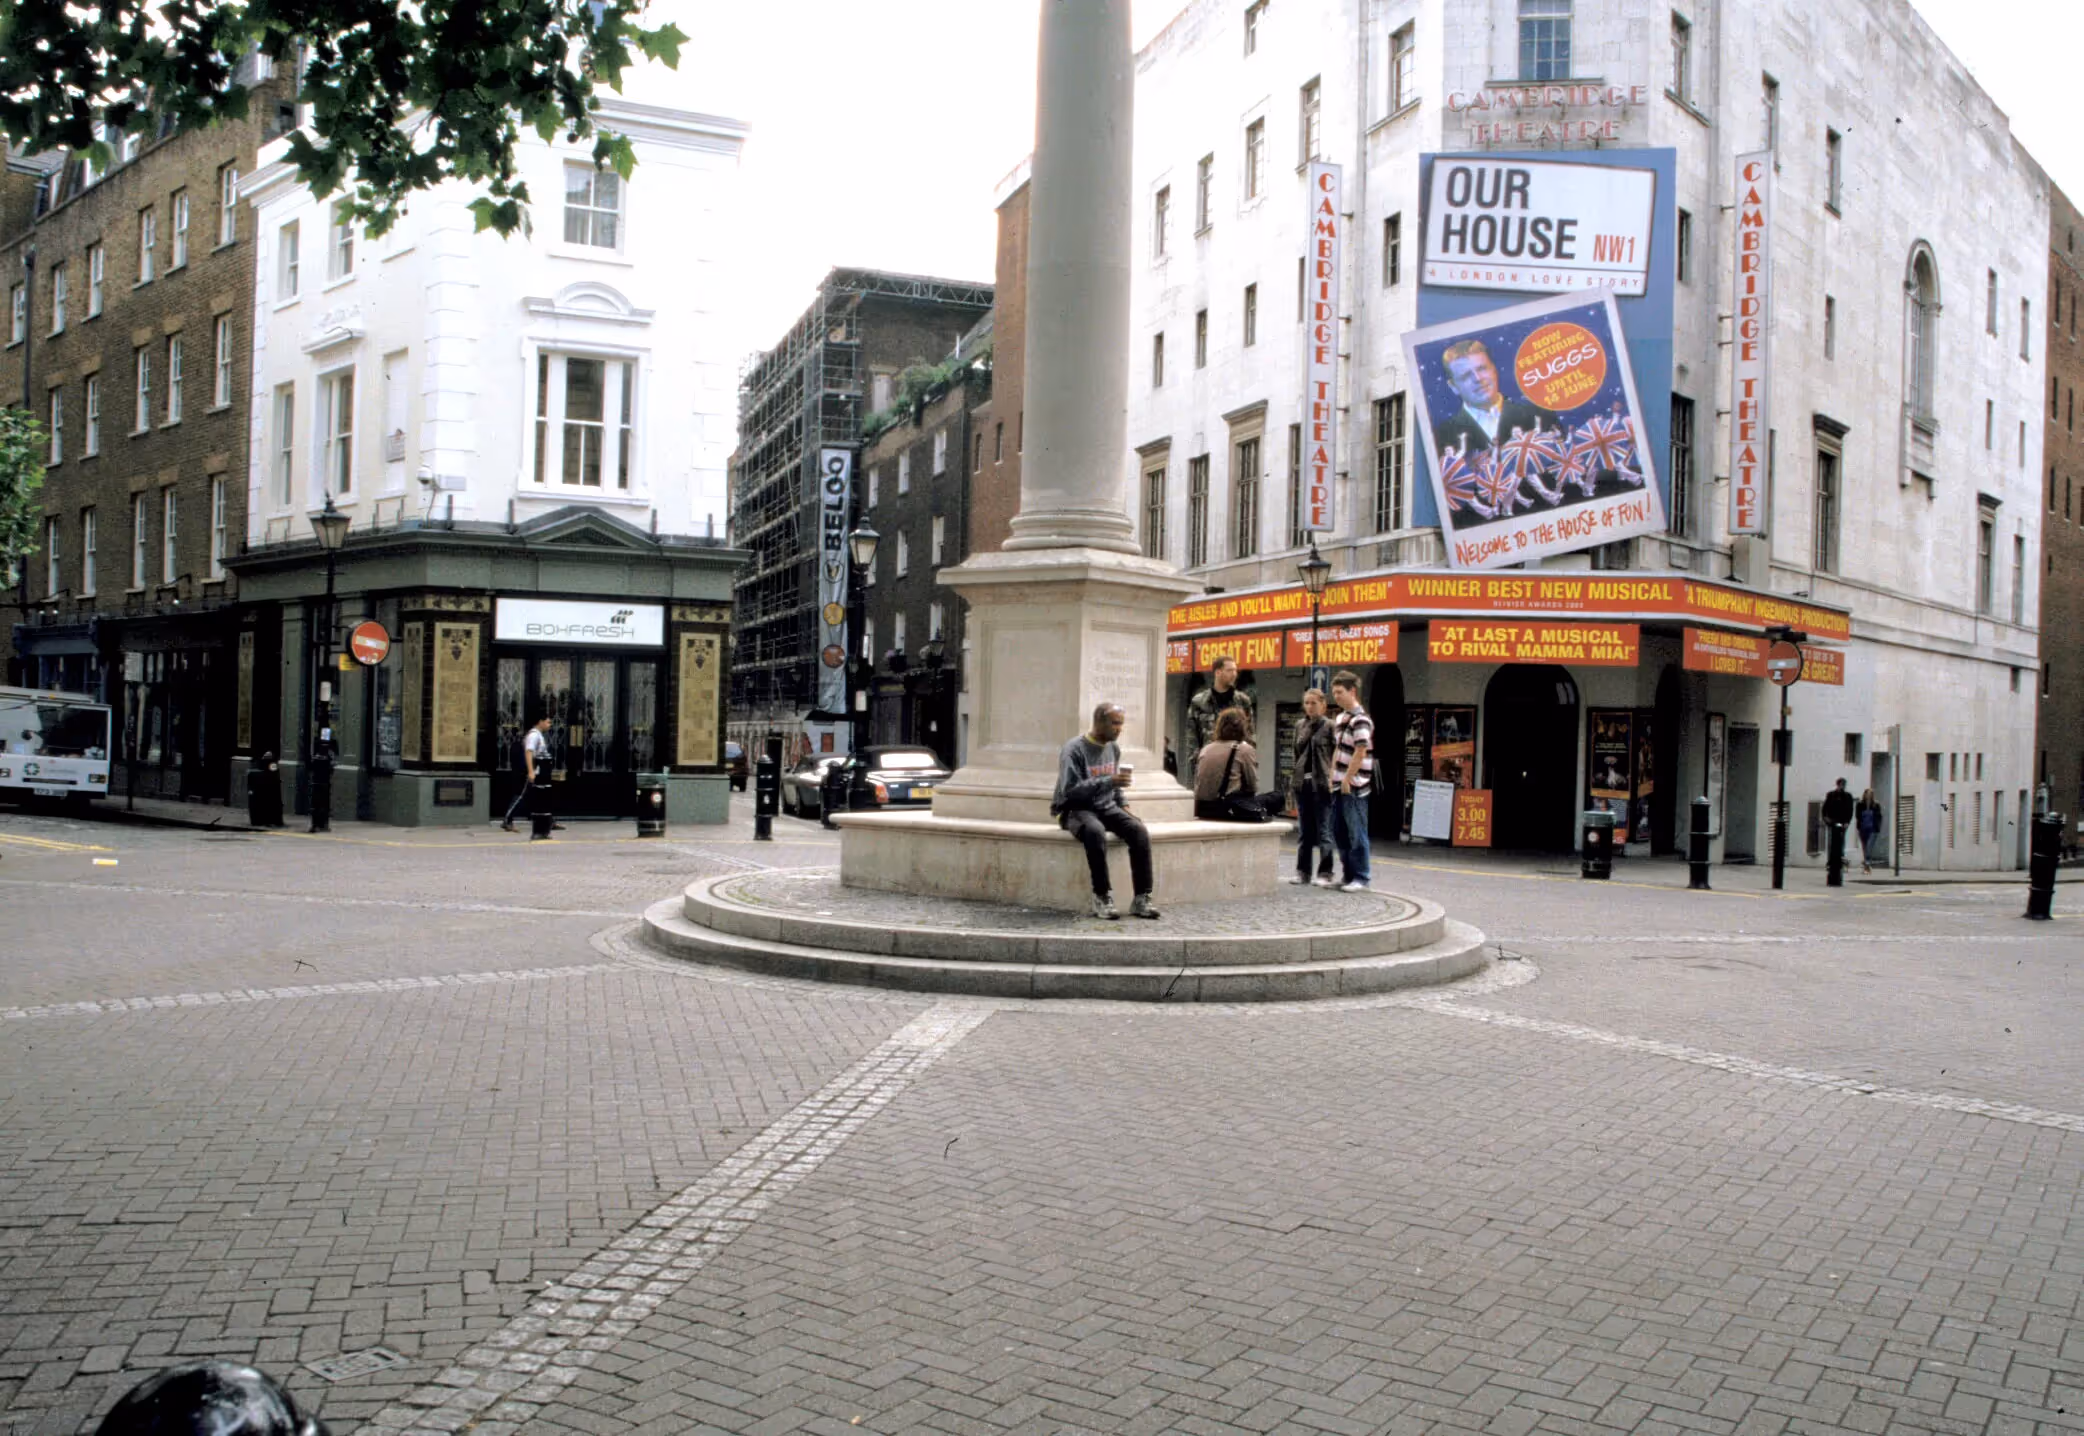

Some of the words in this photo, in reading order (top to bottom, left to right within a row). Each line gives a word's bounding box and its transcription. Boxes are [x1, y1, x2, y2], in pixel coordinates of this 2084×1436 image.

[1449, 86, 1648, 111] CAMBRIDGE
[1471, 120, 1620, 144] THEATRE
[1446, 166, 1531, 209] OUR
[1441, 213, 1578, 259] HOUSE
[1593, 234, 1635, 263] NW1
[1314, 172, 1336, 365] CAMBRIDGE
[1739, 161, 1764, 361] CAMBRIDGE
[1428, 269, 1436, 277] A
[1449, 271, 1518, 282] LONDON
[1531, 274, 1573, 285] LOVE
[1587, 277, 1639, 287] STORY
[1518, 332, 1585, 368] FEATURING
[1532, 330, 1561, 350] NOW
[1523, 343, 1598, 387] SUGGS
[1545, 369, 1586, 393] UNTIL
[1564, 375, 1597, 398] JUNE
[1311, 381, 1330, 526] THEATRE
[1737, 378, 1758, 528] THEATRE
[1513, 530, 1528, 549] TO
[1530, 524, 1556, 545] THE
[1557, 509, 1598, 541] HOUSE
[1601, 506, 1615, 527] OF
[1408, 579, 1481, 598] WINNER
[1487, 580, 1534, 599] BEST
[1540, 582, 1583, 600] NEW
[1588, 582, 1673, 601] MUSICAL
[1171, 610, 1186, 624] THE
[1188, 606, 1217, 622] AISLES
[1219, 603, 1238, 619] AND
[1240, 598, 1272, 616] YOU'LL
[1274, 593, 1302, 611] WANT
[1322, 587, 1349, 607] JOIN
[1755, 600, 1800, 625] INGENIOUS
[1363, 625, 1390, 638] SONGS
[1473, 627, 1519, 642] LAST
[1522, 628, 1535, 642] A
[1541, 629, 1623, 644] MUSICAL
[1429, 641, 1454, 655] TO
[1461, 642, 1510, 656] RIVAL
[1516, 643, 1585, 658] MAMMA
[1458, 808, 1486, 822] 3.00
[1458, 825, 1485, 840] 7.45
